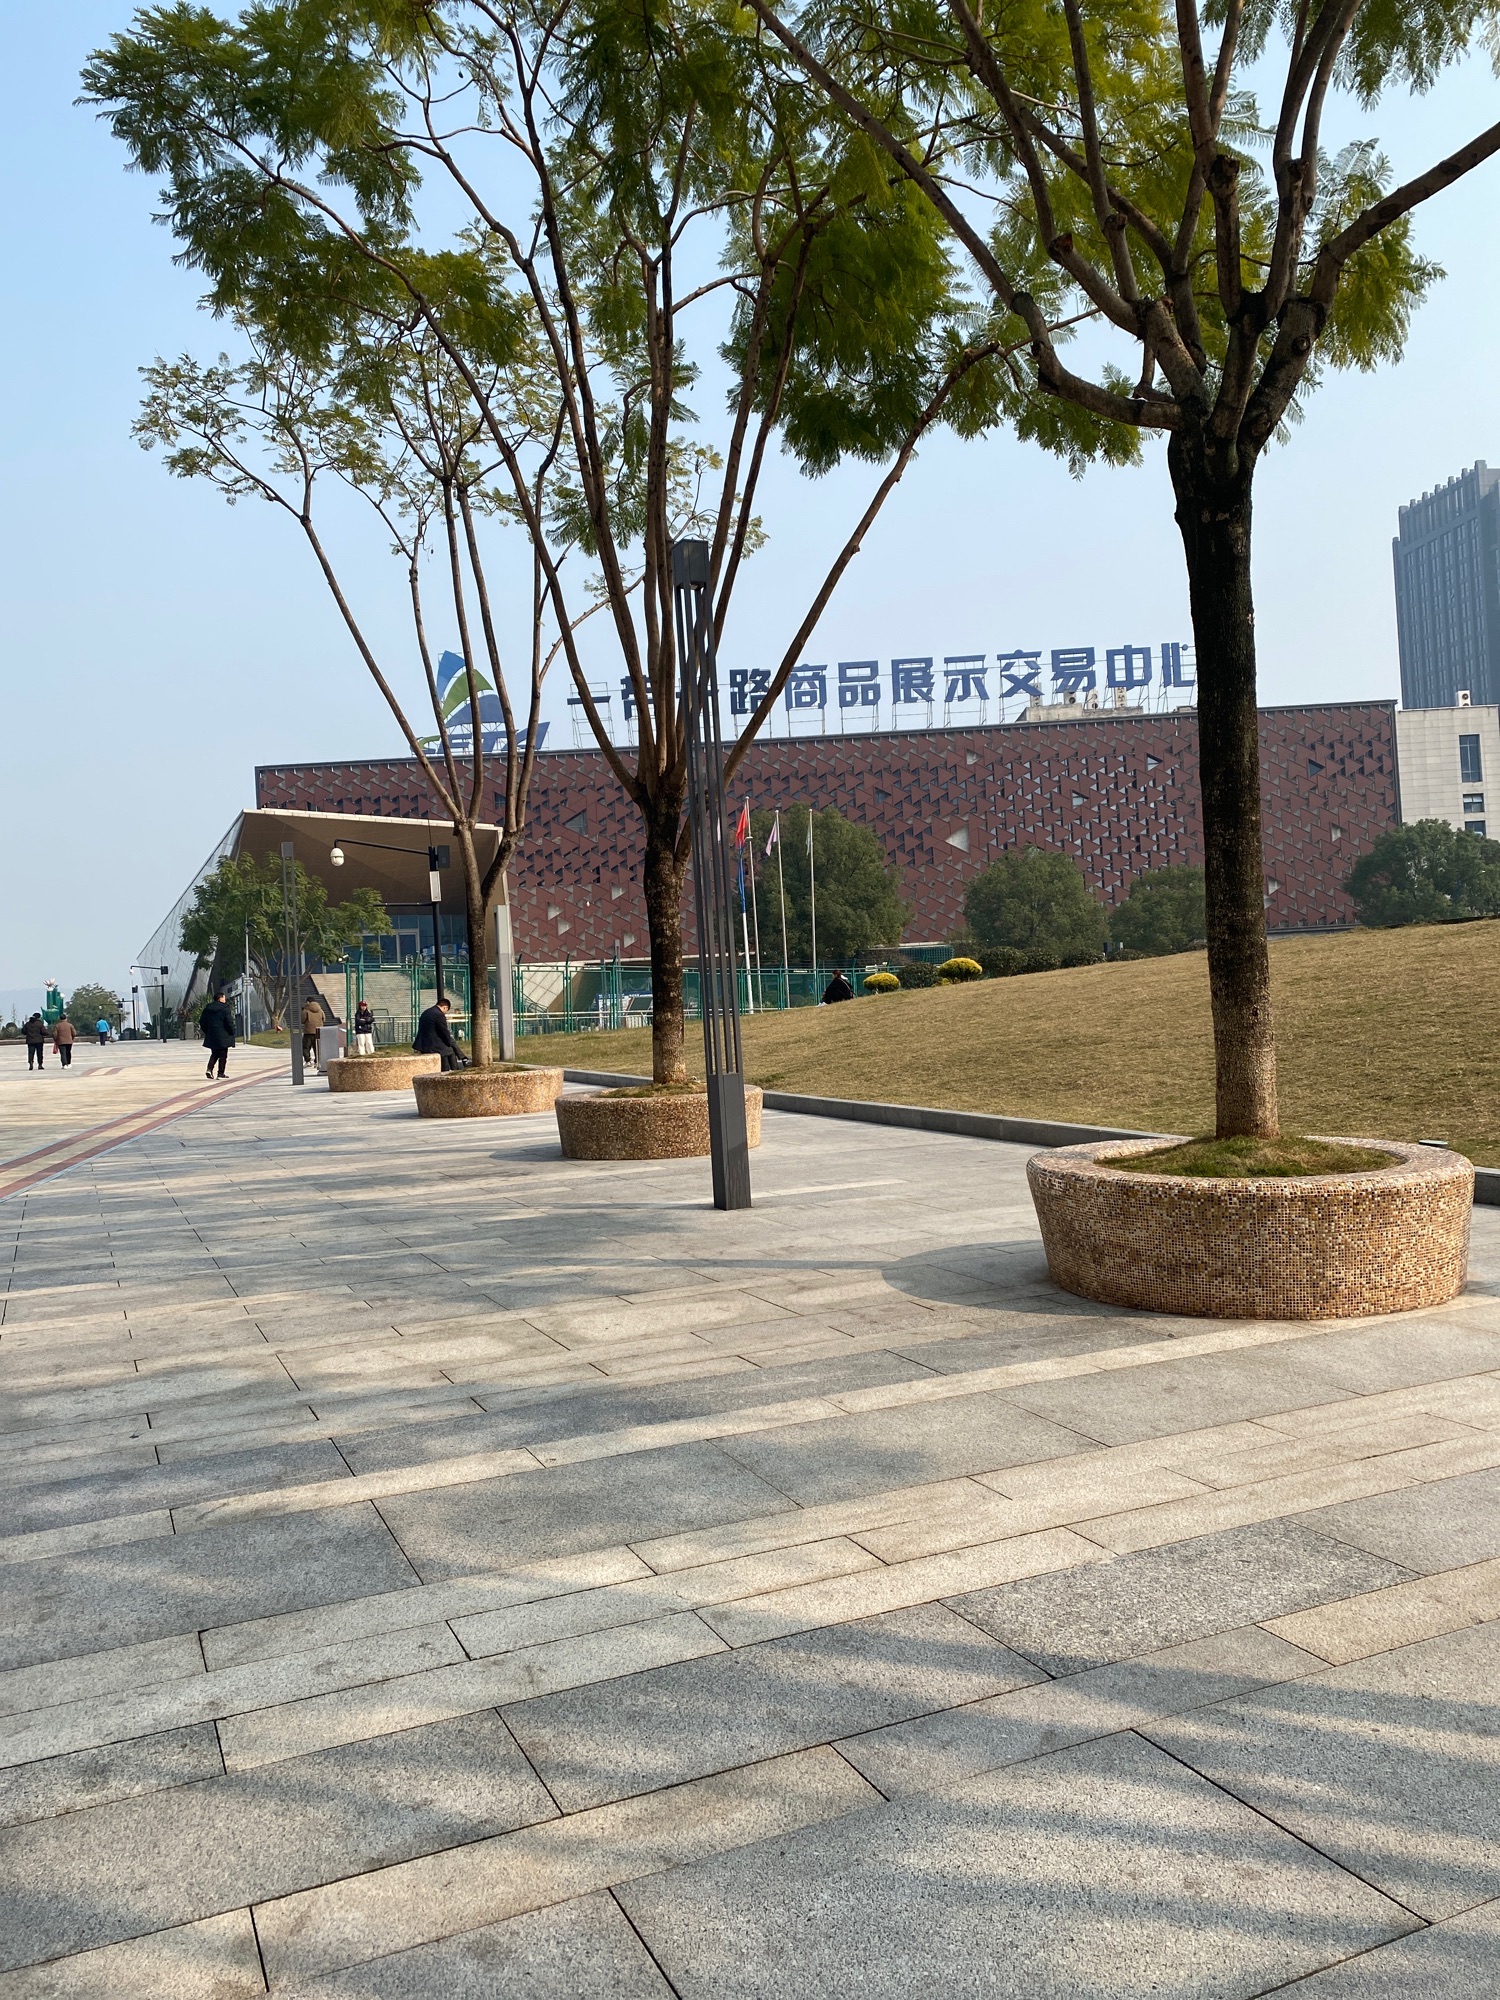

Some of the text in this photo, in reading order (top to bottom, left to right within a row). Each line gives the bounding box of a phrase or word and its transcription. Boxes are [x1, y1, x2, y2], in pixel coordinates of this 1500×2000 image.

[567, 642, 1196, 721] 一路商品展示交易中心
